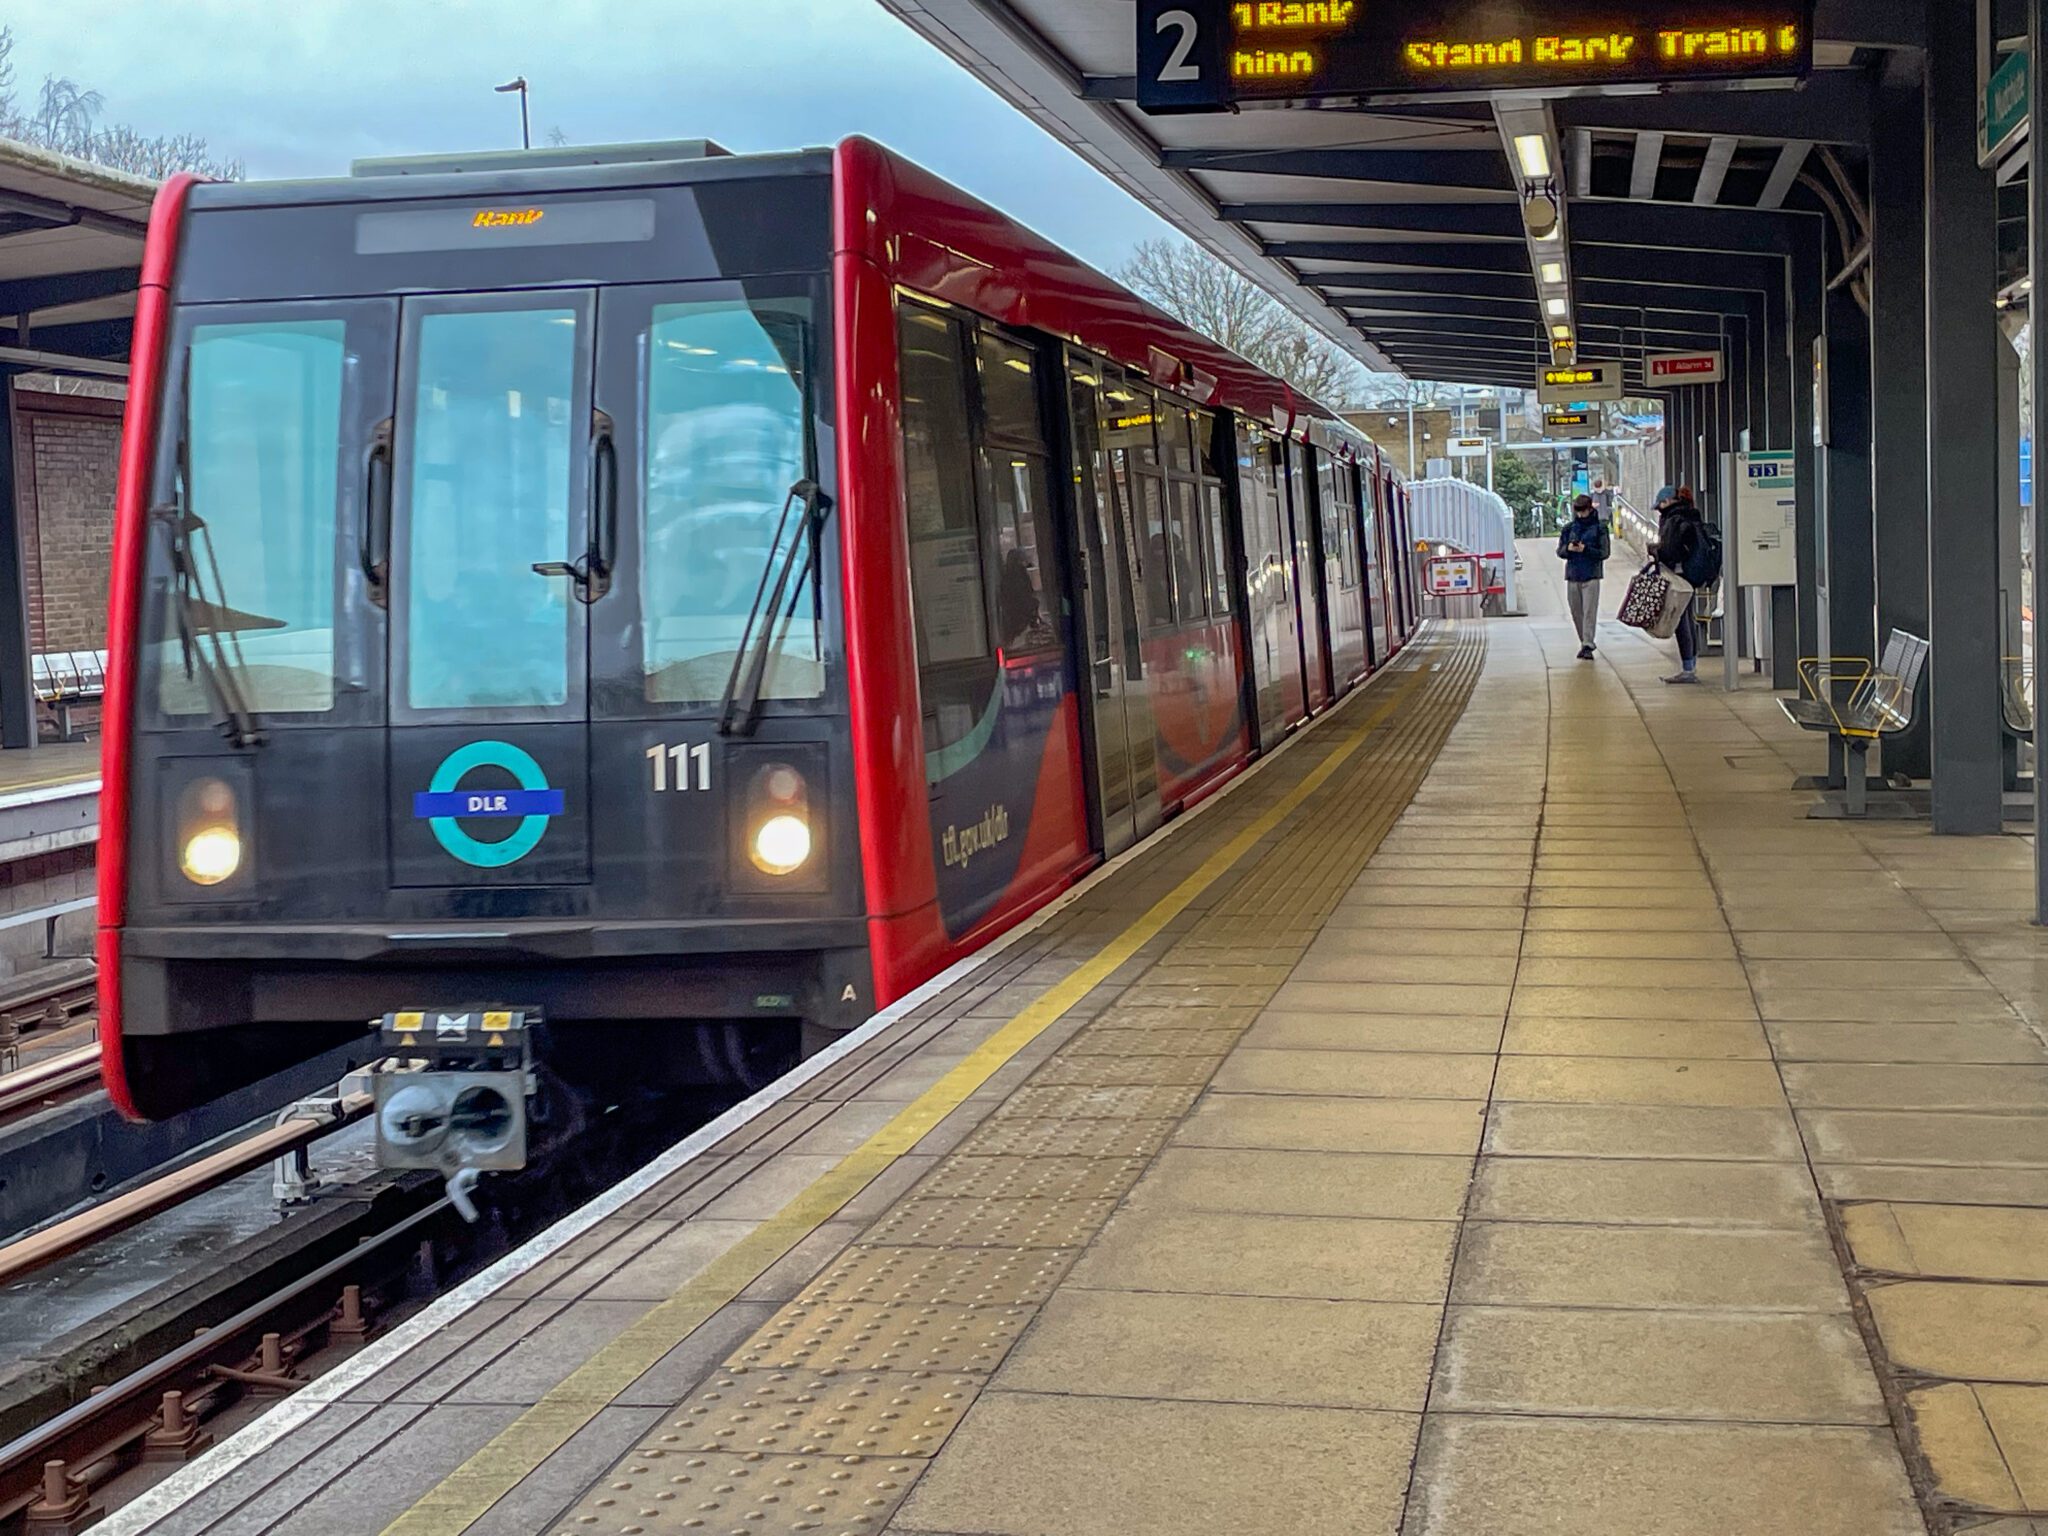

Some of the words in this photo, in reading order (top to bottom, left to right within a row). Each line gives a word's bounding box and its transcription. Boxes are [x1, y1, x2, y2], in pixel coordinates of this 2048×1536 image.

[1156, 10, 1199, 81] 2
[1658, 27, 1767, 57] Train
[1554, 371, 1576, 383] Way
[1576, 370, 1594, 382] out
[646, 741, 711, 791] 111
[468, 796, 508, 812] DLR
[841, 984, 857, 1002] A
